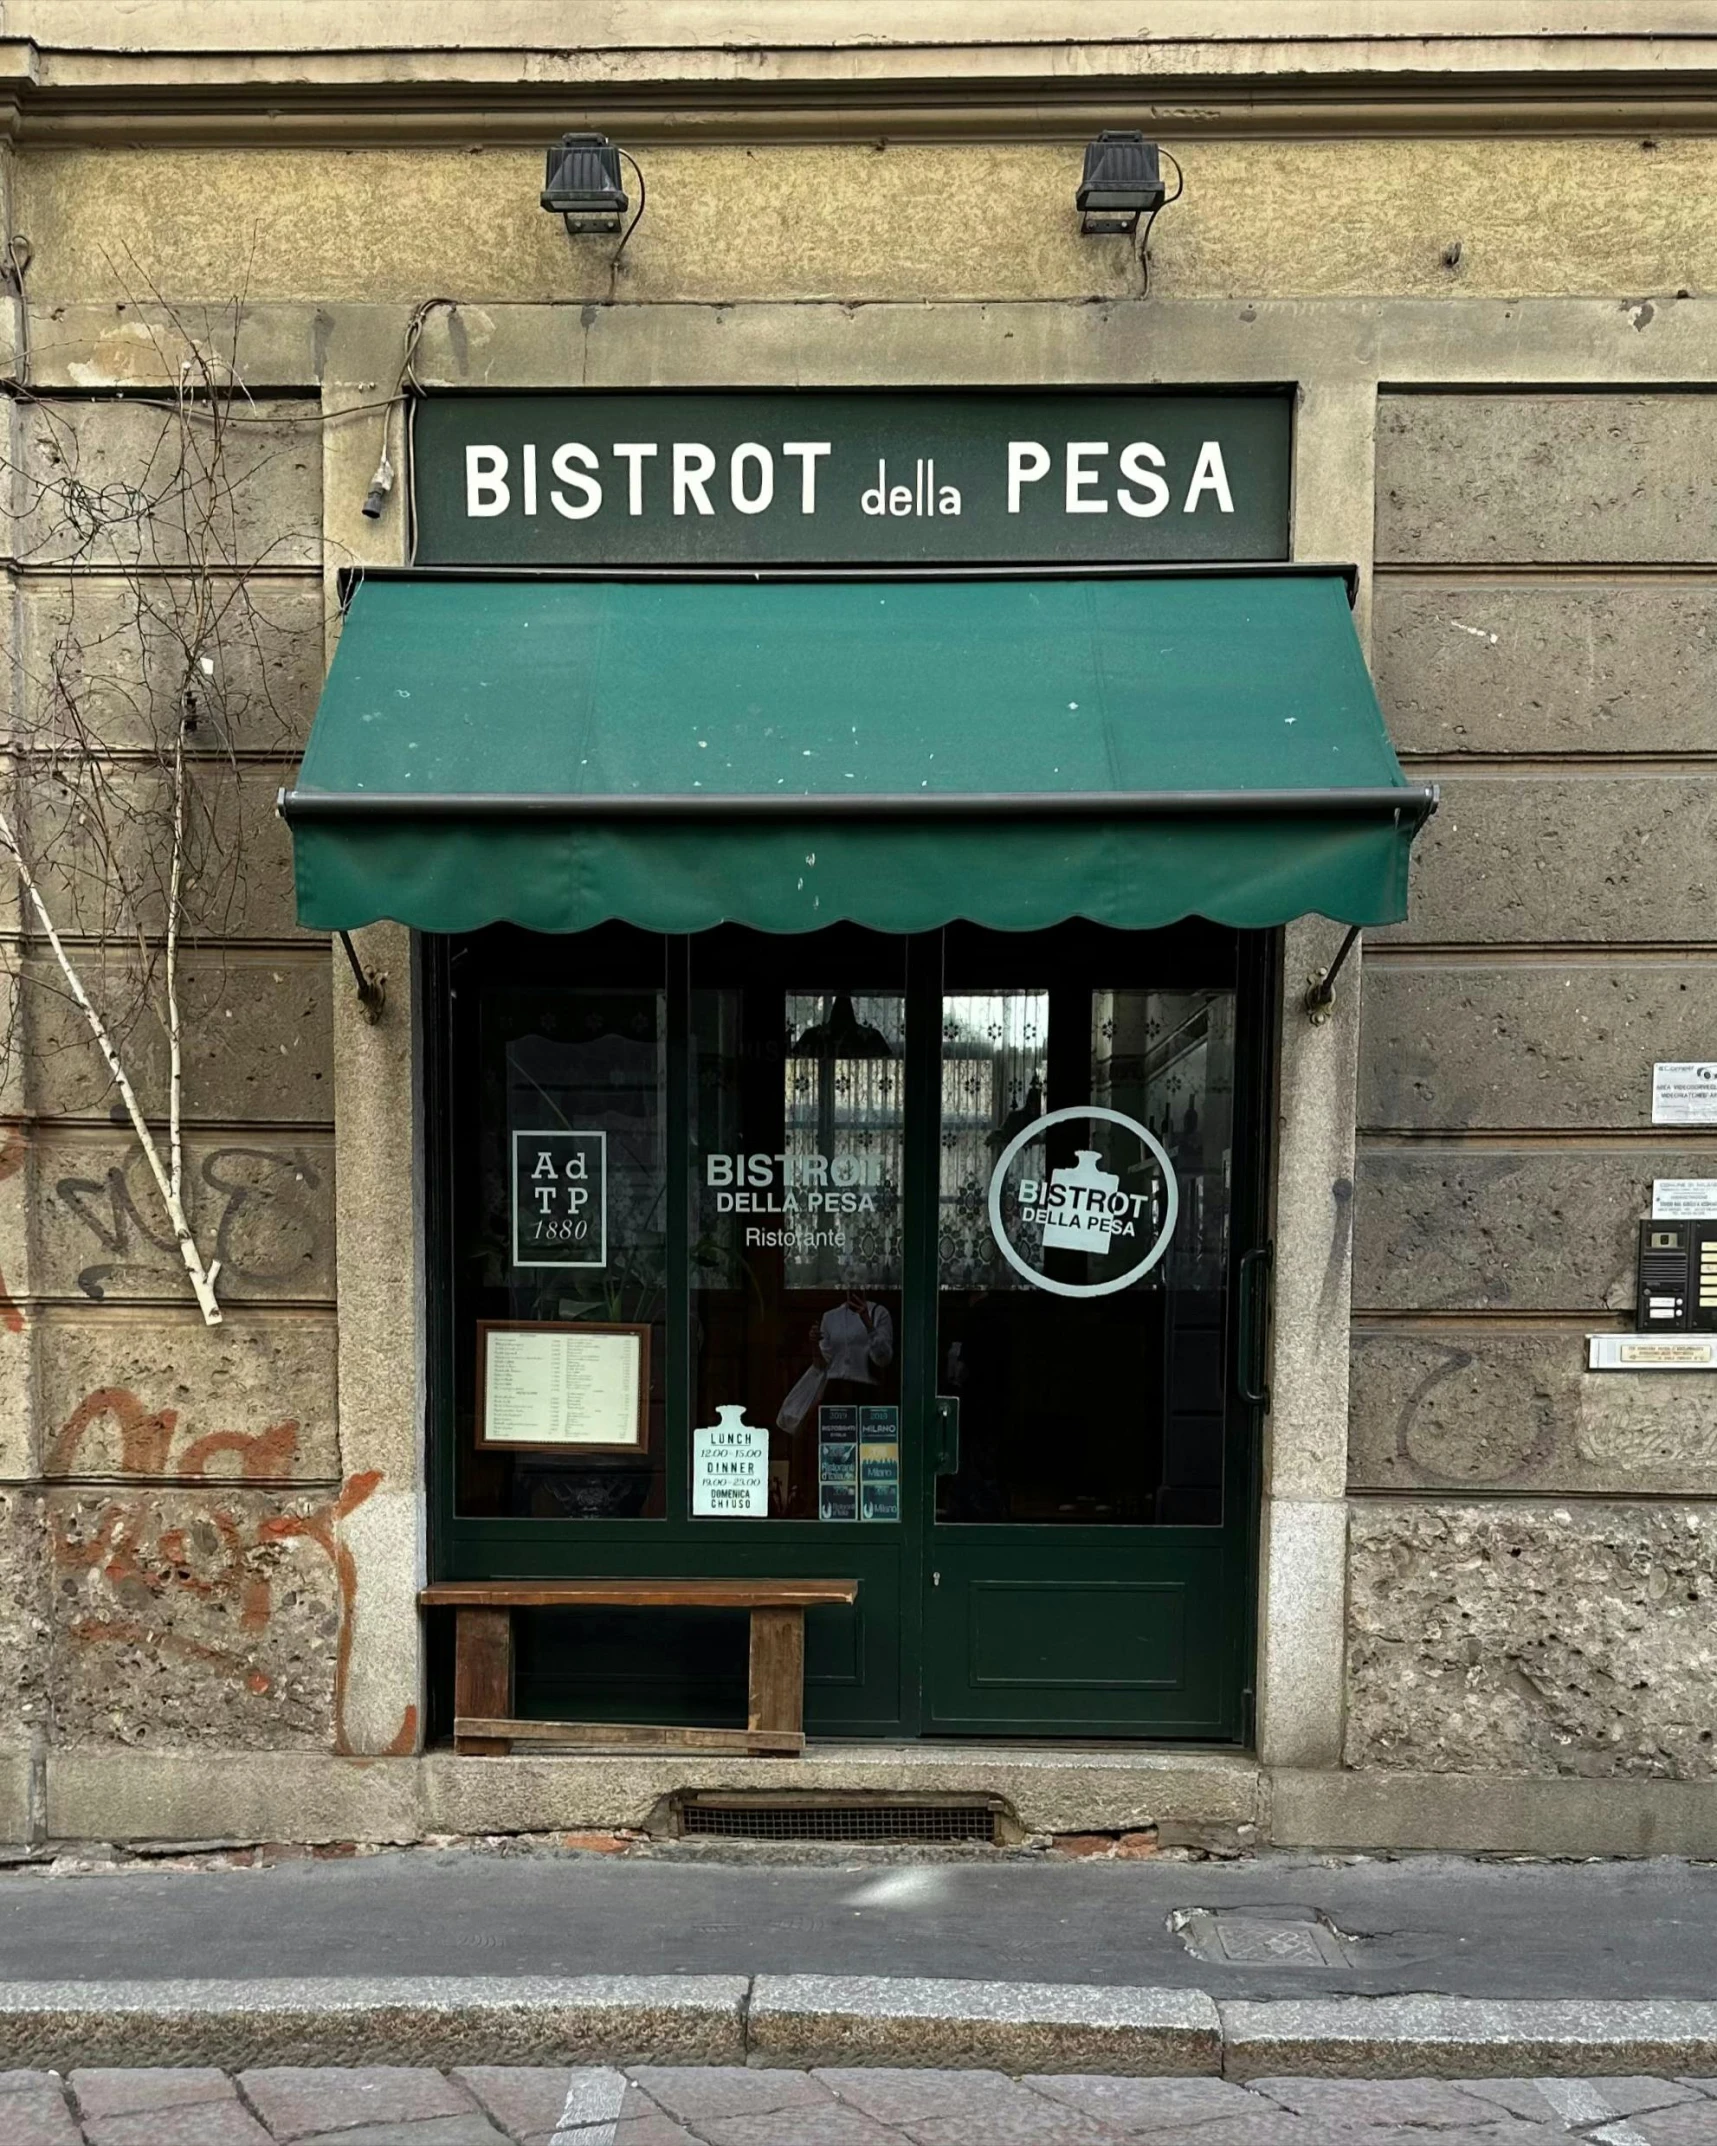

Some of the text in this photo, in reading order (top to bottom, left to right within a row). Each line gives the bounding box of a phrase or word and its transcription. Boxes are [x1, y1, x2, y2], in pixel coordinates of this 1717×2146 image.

[465, 440, 1236, 520] BISTROT della PESA
[706, 1154, 886, 1187] BISTROT
[716, 1192, 876, 1213] DELLA PESA
[1018, 1179, 1149, 1219] BISTROT
[533, 1219, 588, 1240] 1880
[1022, 1206, 1136, 1238] DELLA PESA
[745, 1227, 847, 1248] Ristorante
[862, 1424, 896, 1433] MILANO
[711, 1433, 752, 1445] LUNCH
[707, 1462, 755, 1473] DINNER
[867, 1468, 892, 1477] Milano
[711, 1489, 750, 1499] DOMENICA
[711, 1499, 751, 1509] CHIUSO
[874, 1504, 897, 1513] Milano
